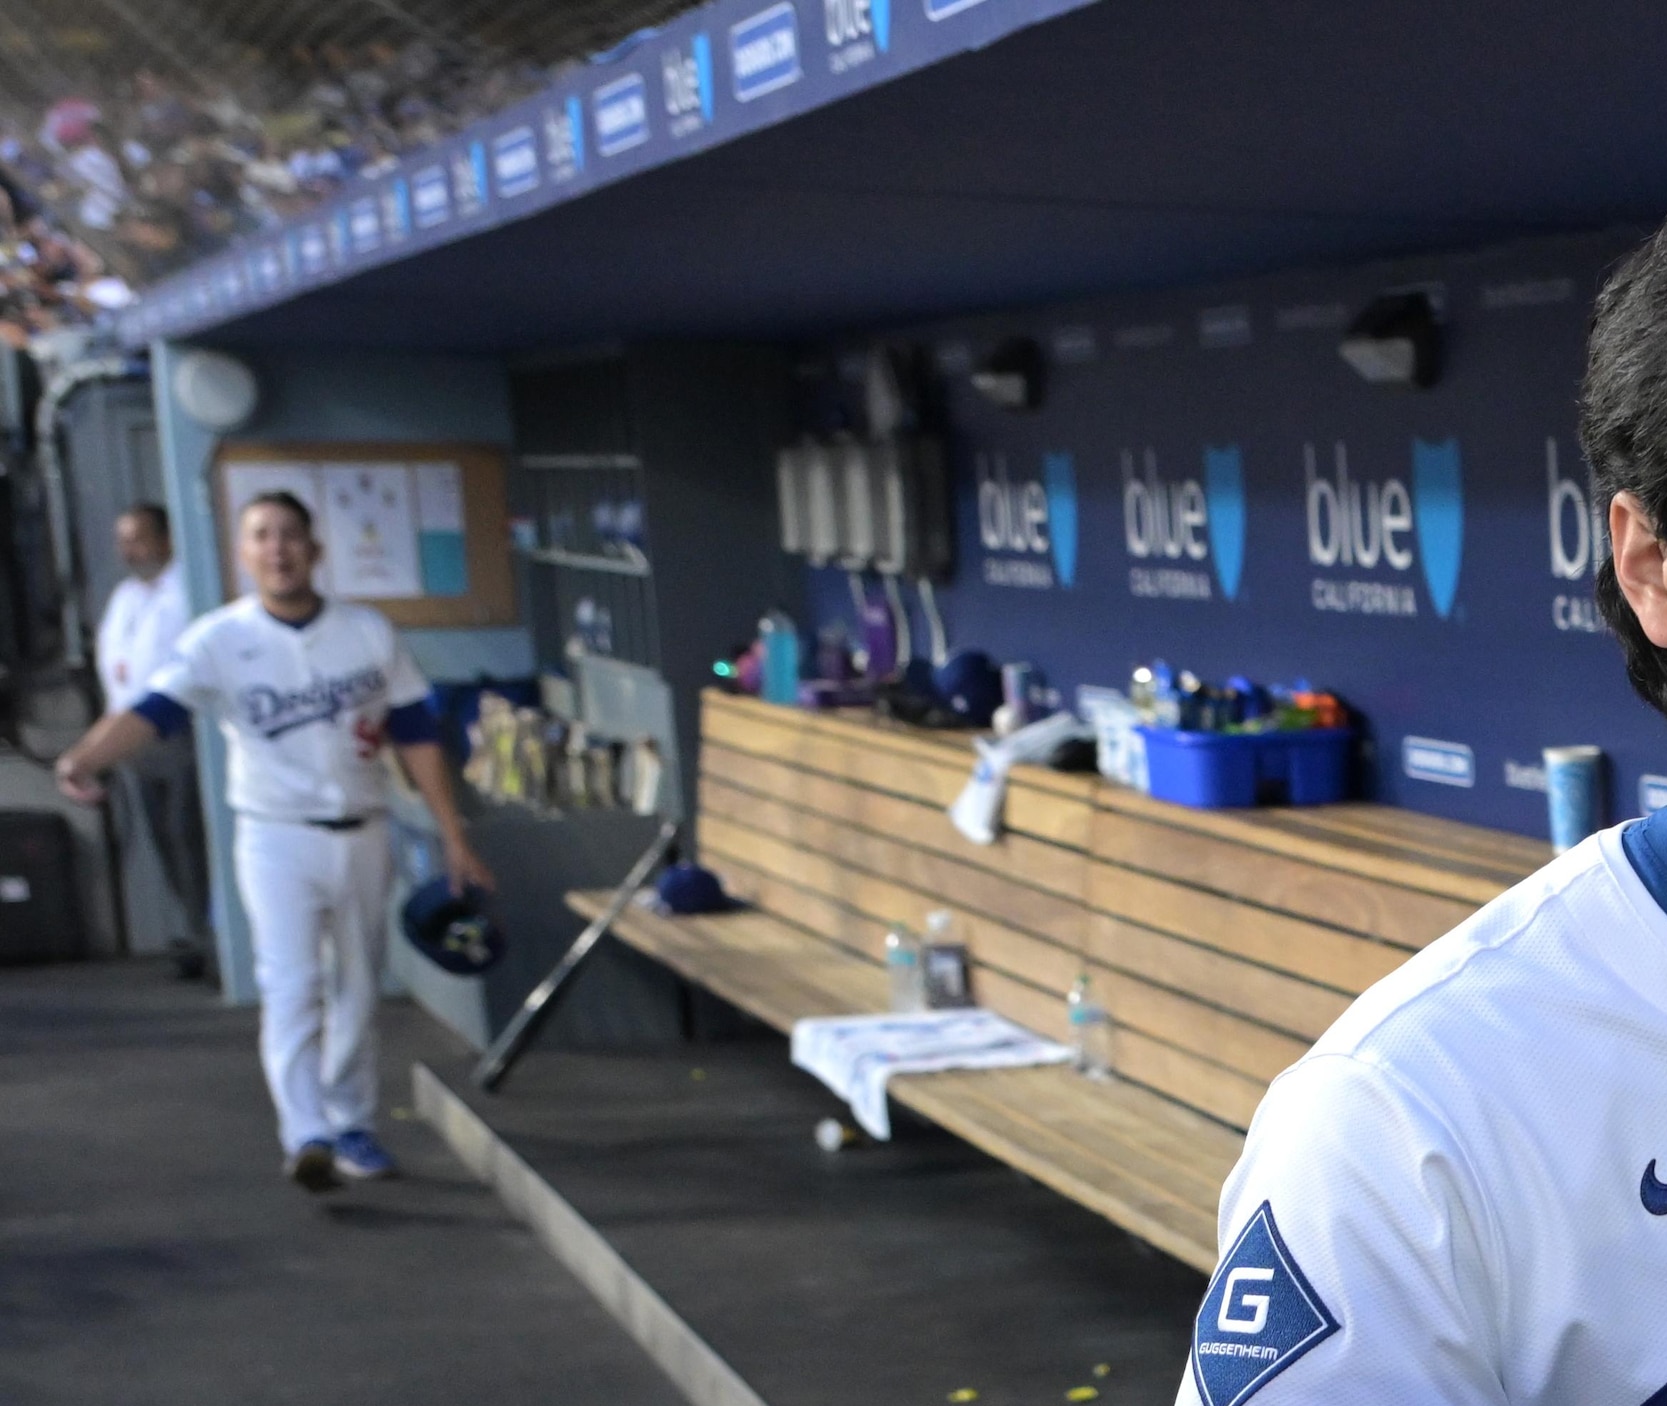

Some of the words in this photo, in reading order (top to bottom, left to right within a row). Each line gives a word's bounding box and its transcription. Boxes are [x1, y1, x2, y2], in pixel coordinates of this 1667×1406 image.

[1121, 447, 1208, 560] blue
[1304, 440, 1413, 571] blue
[1217, 1266, 1275, 1334] G
[1199, 1342, 1279, 1361] GUGGENHEIM
